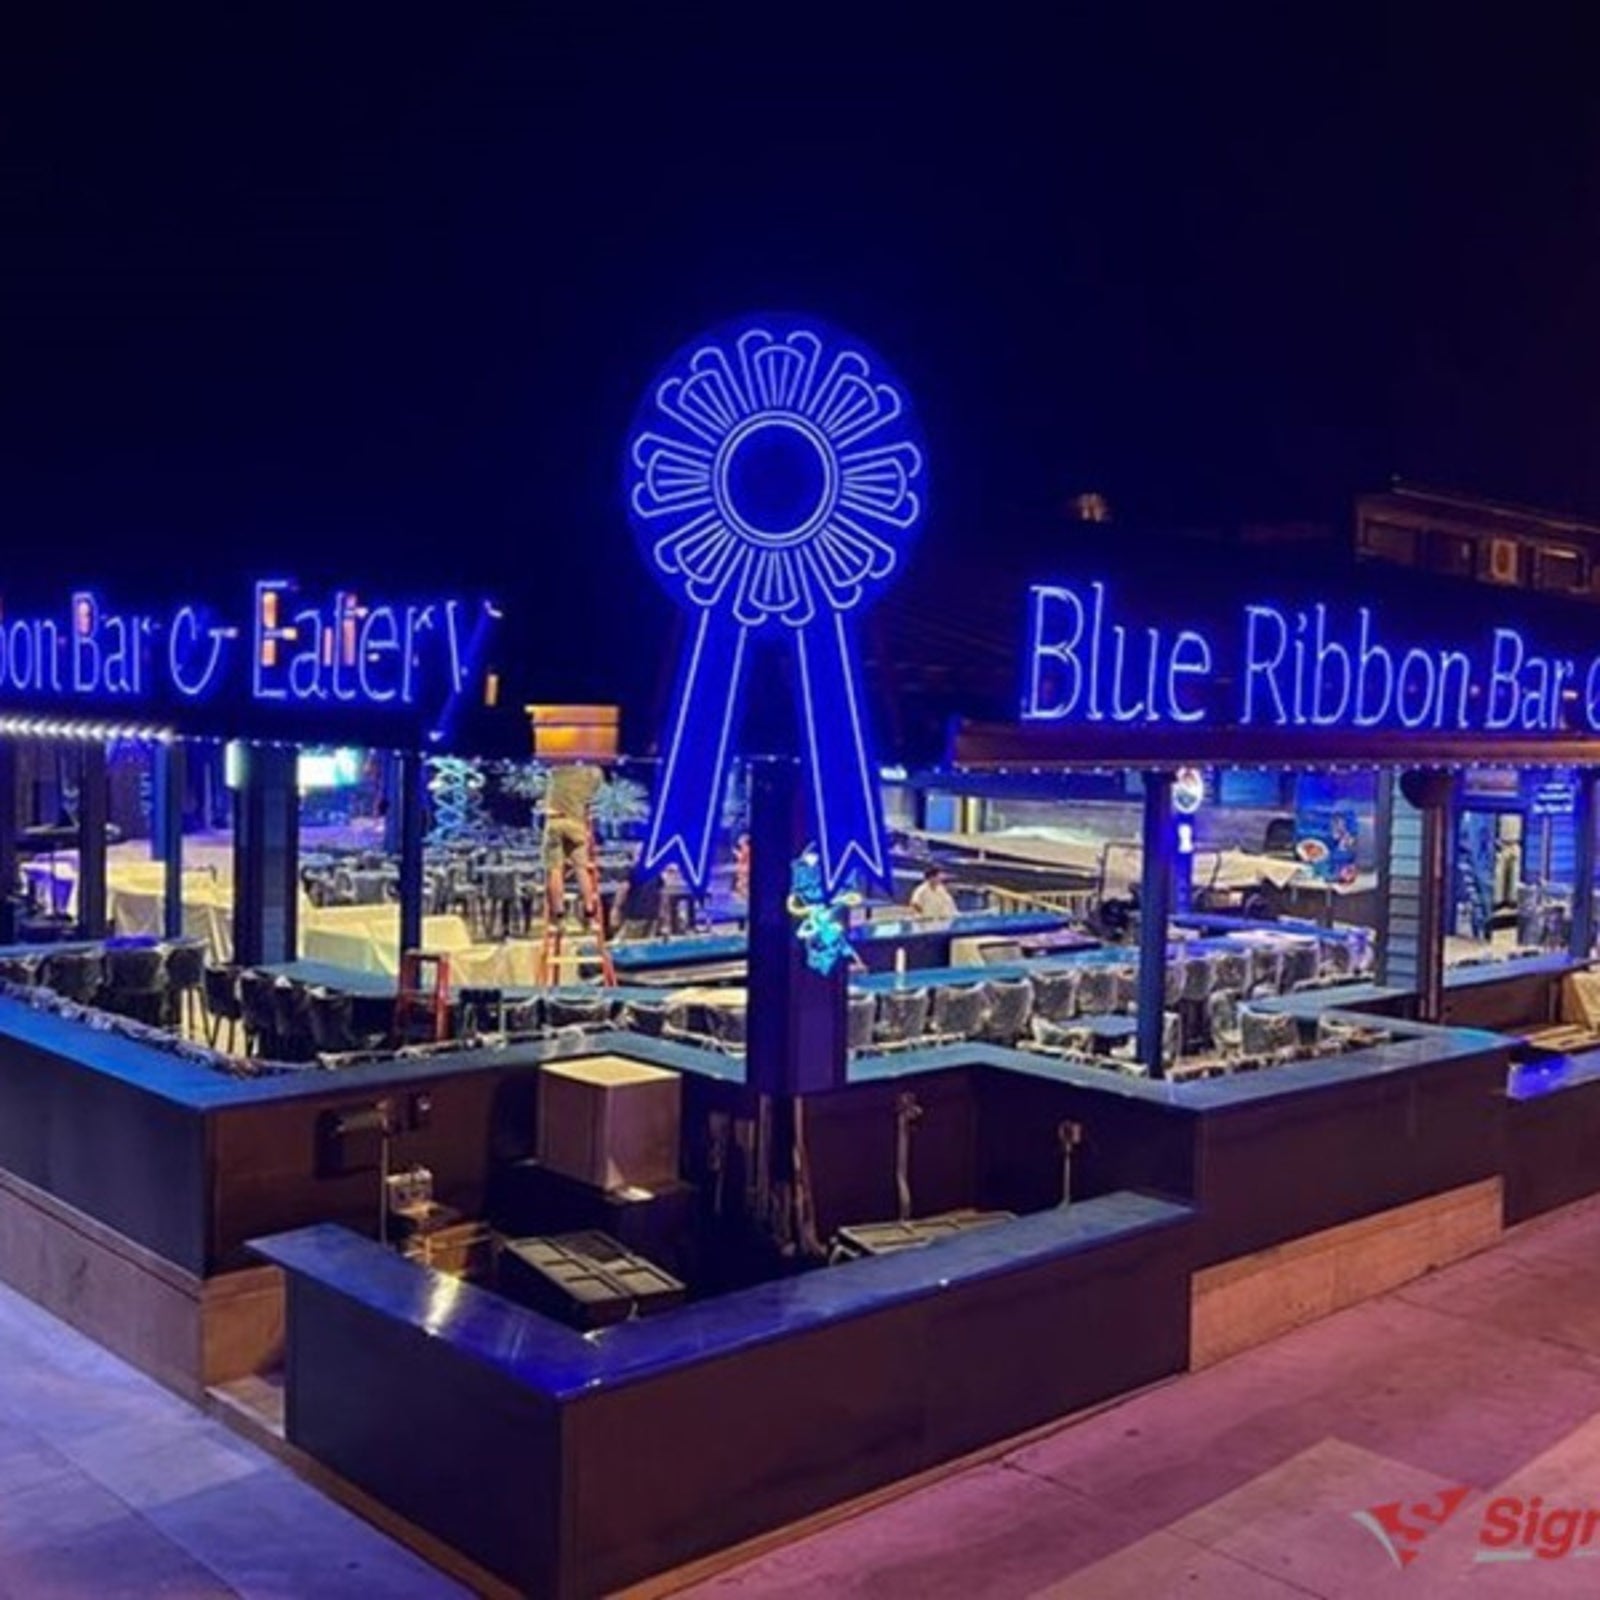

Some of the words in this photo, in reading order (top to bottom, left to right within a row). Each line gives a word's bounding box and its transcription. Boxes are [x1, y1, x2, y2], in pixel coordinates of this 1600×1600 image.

[0, 617, 62, 691] on
[73, 592, 154, 692] Bar
[169, 605, 238, 695] &
[253, 579, 503, 741] Eatery
[1020, 581, 1212, 722] Blue
[1239, 603, 1470, 728] Ribbon
[1484, 628, 1574, 729] Bar
